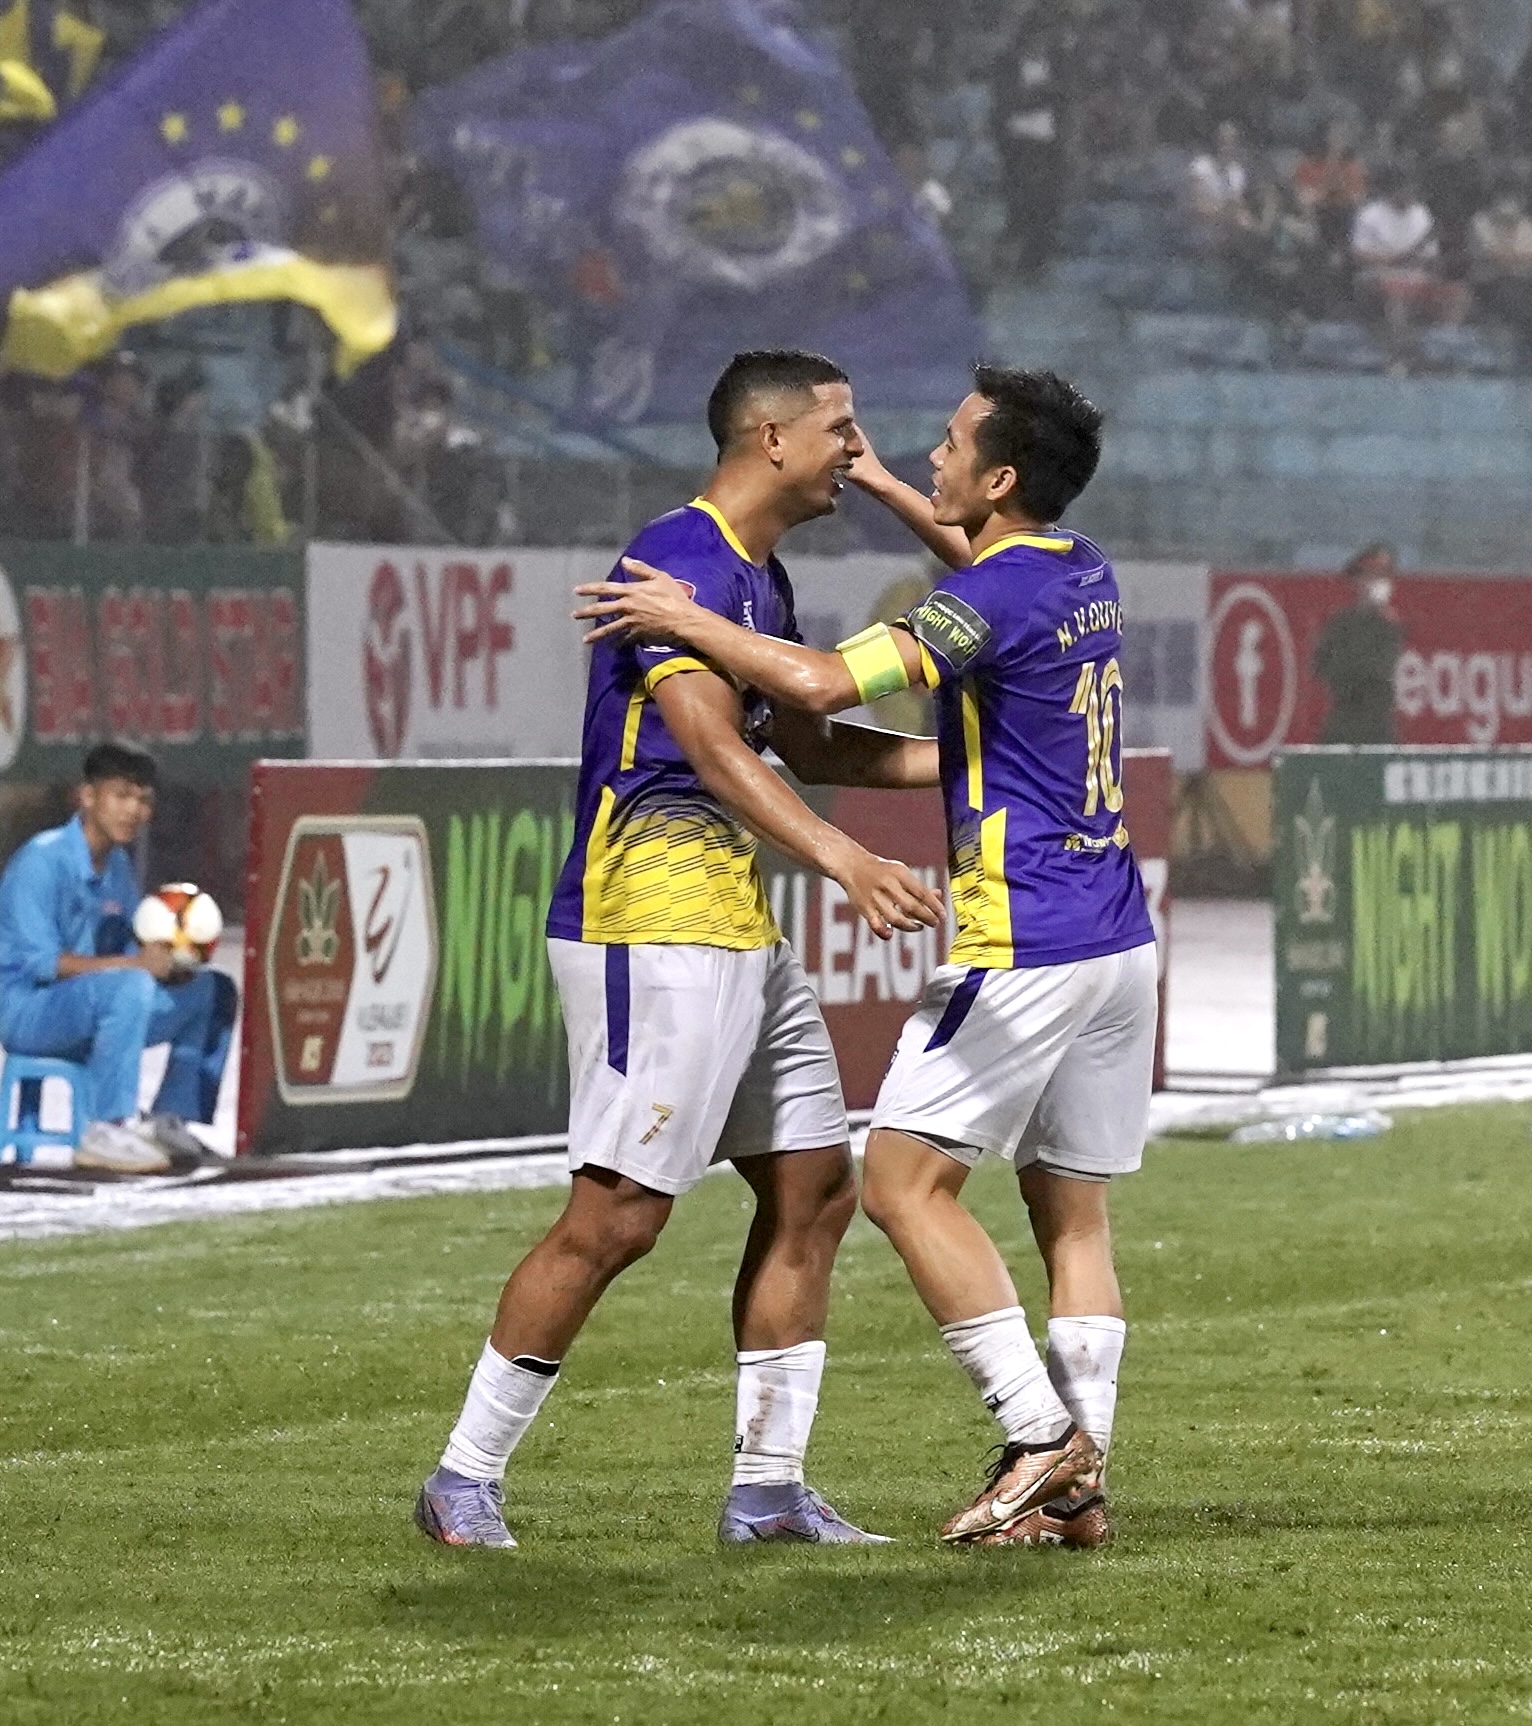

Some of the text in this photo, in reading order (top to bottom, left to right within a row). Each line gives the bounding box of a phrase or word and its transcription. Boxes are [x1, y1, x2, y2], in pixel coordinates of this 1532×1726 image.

[413, 561, 514, 711] VPF
[1068, 658, 1124, 816] 10
[1352, 821, 1461, 1006] NIGHT
[640, 1103, 674, 1145] 7
